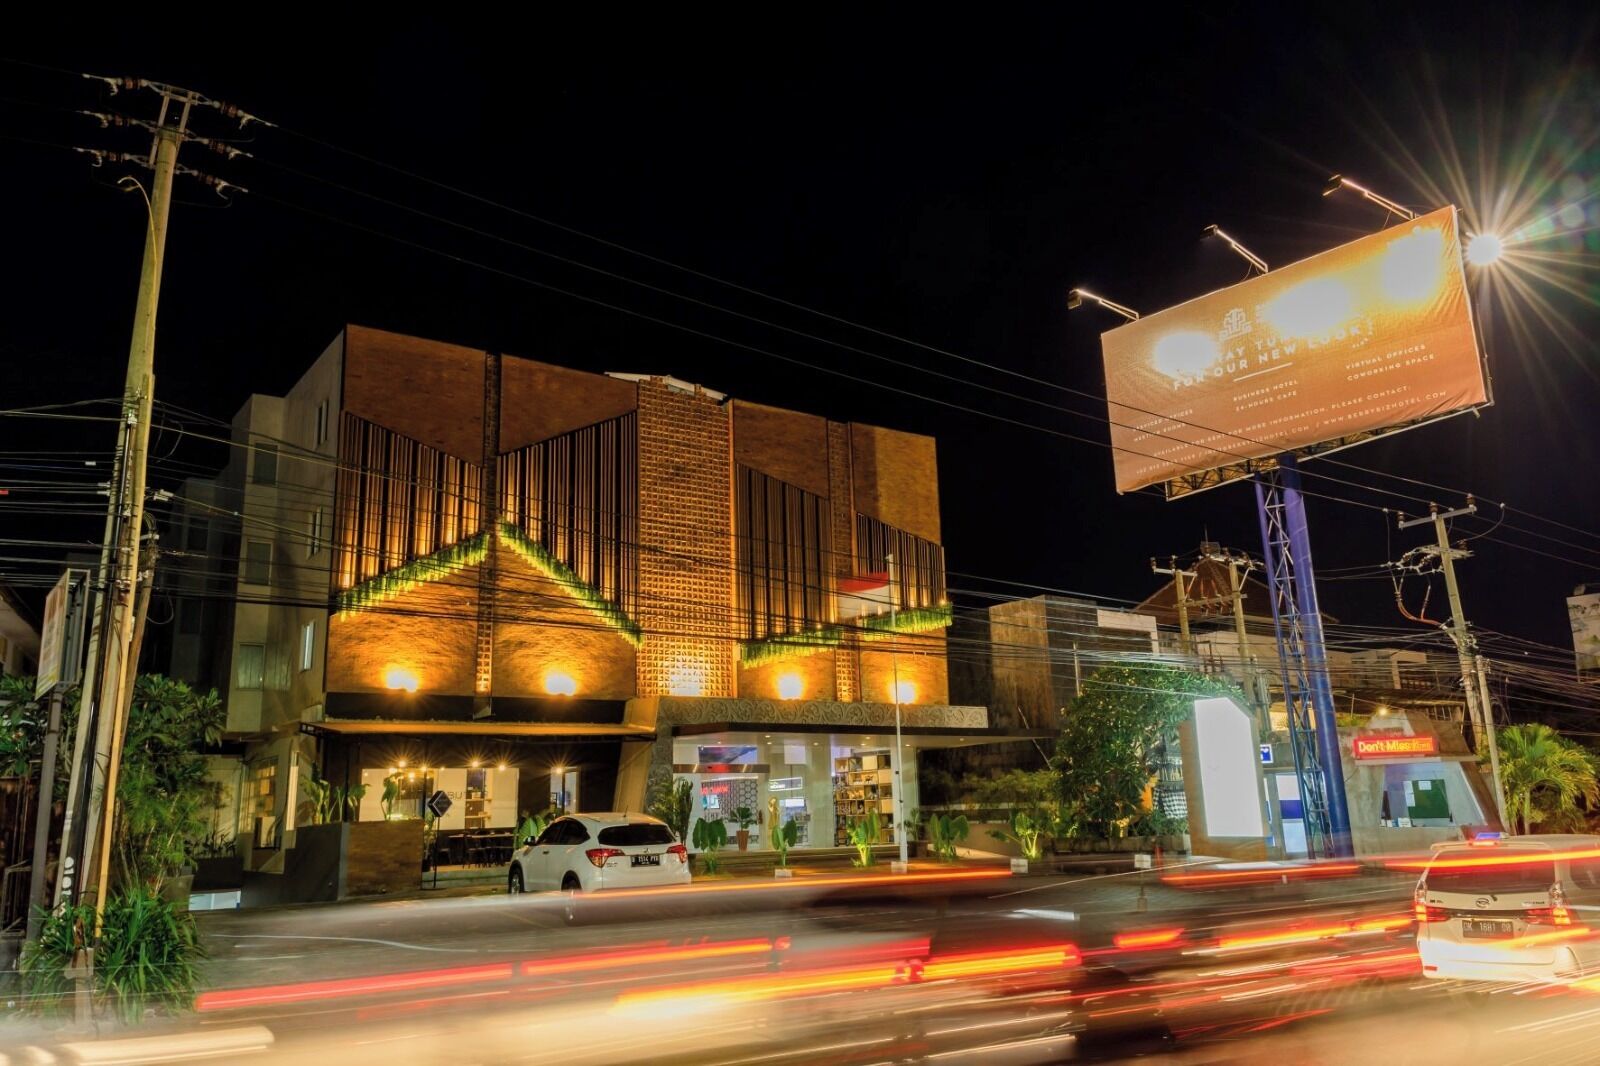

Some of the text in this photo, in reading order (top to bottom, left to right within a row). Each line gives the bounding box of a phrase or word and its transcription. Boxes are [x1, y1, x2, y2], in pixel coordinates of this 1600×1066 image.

[1213, 360, 1248, 378] OUR
[1258, 343, 1297, 363] NEW
[1345, 344, 1426, 370] VIRTUAL OFFICES
[1346, 354, 1434, 381] COWORKING SPACE
[1232, 379, 1297, 401] BUSINESS HOTEL
[1331, 398, 1363, 409] PLEASE
[1358, 740, 1384, 753] Don't
